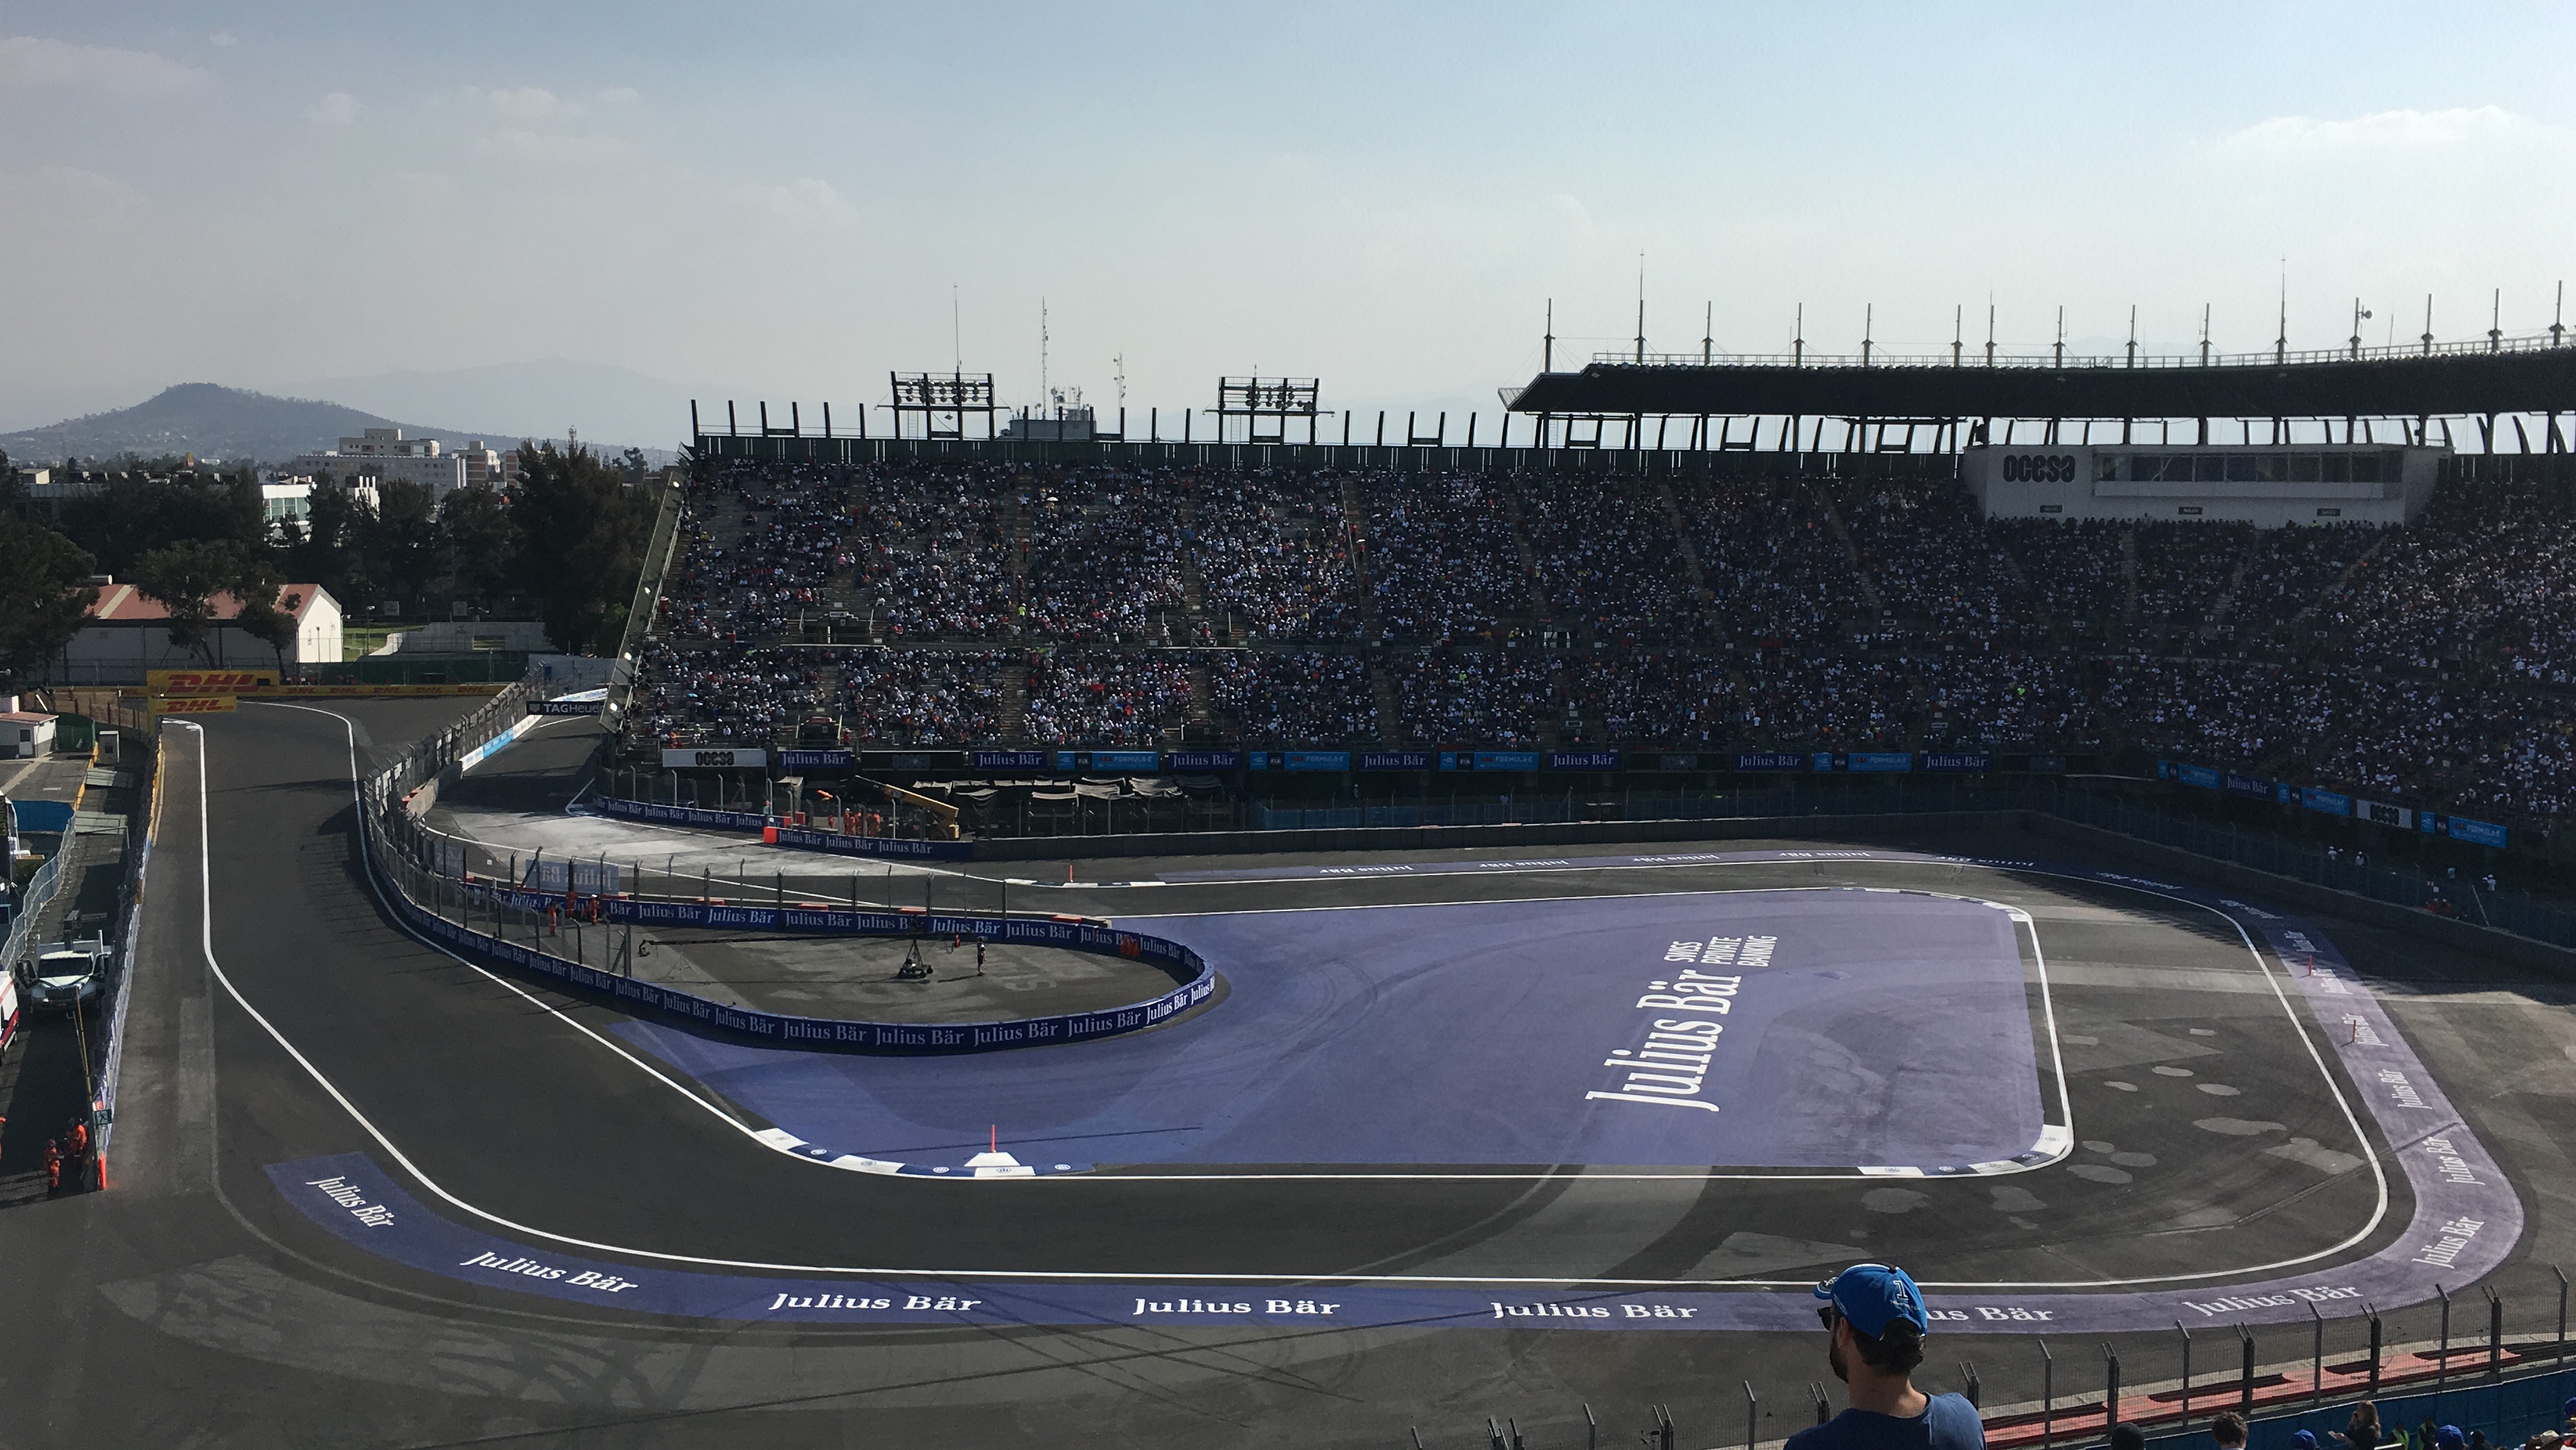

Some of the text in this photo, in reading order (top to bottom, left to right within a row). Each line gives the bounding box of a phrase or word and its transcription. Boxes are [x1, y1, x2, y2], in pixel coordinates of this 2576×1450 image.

[166, 674, 259, 692] DHL
[166, 699, 223, 712] DHL
[782, 752, 847, 766] Julius Bär
[979, 754, 1042, 767] Julius Bär
[1173, 755, 1235, 768] Julius Bär
[1364, 755, 1426, 768] Julius Bär
[1554, 755, 1614, 767] Julius Bär
[1740, 755, 1800, 768] Julius Bär
[1926, 756, 1987, 769] Julius Bär
[2227, 776, 2250, 790] Julius
[645, 806, 685, 820] Julius Bär
[688, 811, 731, 824] Julius Bär
[736, 815, 762, 827] Julius
[778, 831, 822, 845] Julius Bär
[826, 836, 874, 850] Julius Bär
[878, 841, 932, 854] Julius Bär
[610, 902, 631, 915] Bär
[638, 905, 701, 919] Julius Bär
[708, 908, 775, 924] Julius Bär
[786, 912, 852, 927] Julius Bär
[857, 915, 896, 930] Julius
[975, 921, 1001, 934] Bär
[1006, 923, 1073, 939] Julius Bär
[1080, 928, 1112, 944] Juius
[492, 941, 526, 964] Julius Bär
[1141, 937, 1180, 960] Julius Bär
[1664, 941, 1703, 962] SWISS
[1700, 936, 1742, 964] PRIVATE
[1737, 935, 1778, 966] BANKING
[530, 953, 566, 977] Julius Bär
[570, 966, 611, 990] Julius Bär
[616, 979, 659, 1004] Julius Bär
[1191, 982, 1210, 1005] Julius
[664, 993, 711, 1019] Julius Bär
[1146, 993, 1188, 1025] Julius Bär
[715, 1007, 775, 1034] Julius Bär
[1067, 1011, 1142, 1038] Julius Bär
[784, 1021, 867, 1042] Julius Bär
[876, 1027, 964, 1047] Julius Bär
[974, 1022, 1058, 1047] Julius Bär
[1585, 969, 1741, 1112] Julius Bär
[2422, 1137, 2485, 1186] Julius Bär
[306, 1176, 394, 1227] Julius Bär
[2411, 1216, 2485, 1269] Julius Bär
[459, 1251, 638, 1292] Julius Bär
[1893, 1281, 1909, 1299] 1
[769, 1293, 982, 1312] Julius Bär
[1133, 1298, 1341, 1316] Julius Bär
[2181, 1285, 2364, 1316] Julius Bär
[1490, 1302, 1698, 1319] Julius Bär
[1974, 1307, 2053, 1321] Bär
